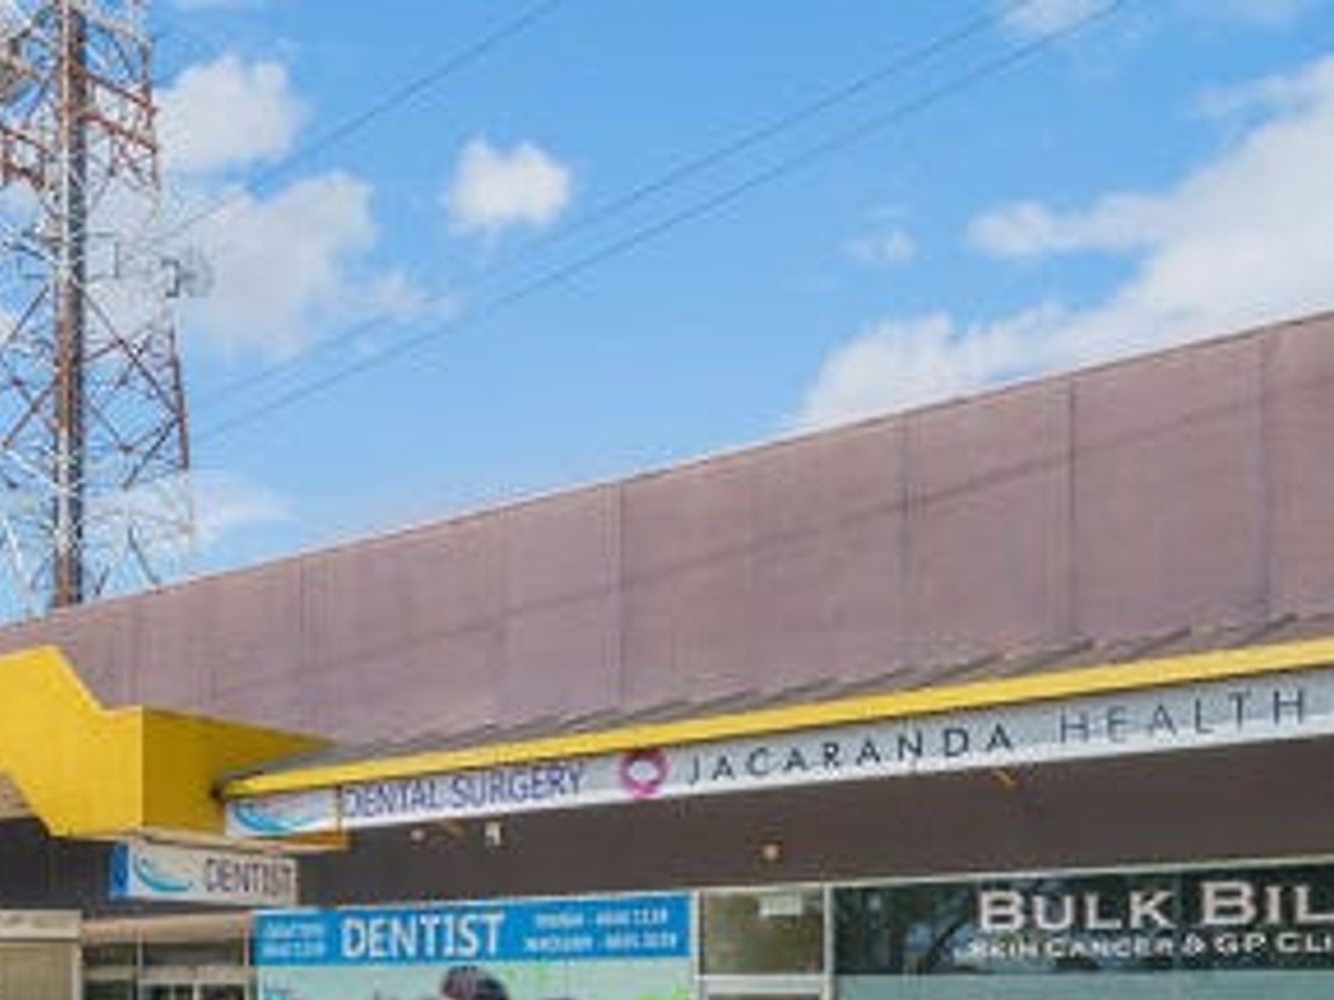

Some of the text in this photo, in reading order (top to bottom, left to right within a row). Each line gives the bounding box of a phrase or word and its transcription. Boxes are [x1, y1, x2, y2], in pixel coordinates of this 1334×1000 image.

[688, 686, 1305, 786] JACARANDA HEALTH
[345, 761, 587, 817] DENTAL SURGERY
[206, 857, 293, 897] DENTIST
[978, 880, 1334, 933] BULK BIL
[340, 911, 505, 959] DENTIST
[1045, 935, 1174, 958] CANCER
[1184, 931, 1207, 955] &
[1215, 933, 1266, 956] GP
